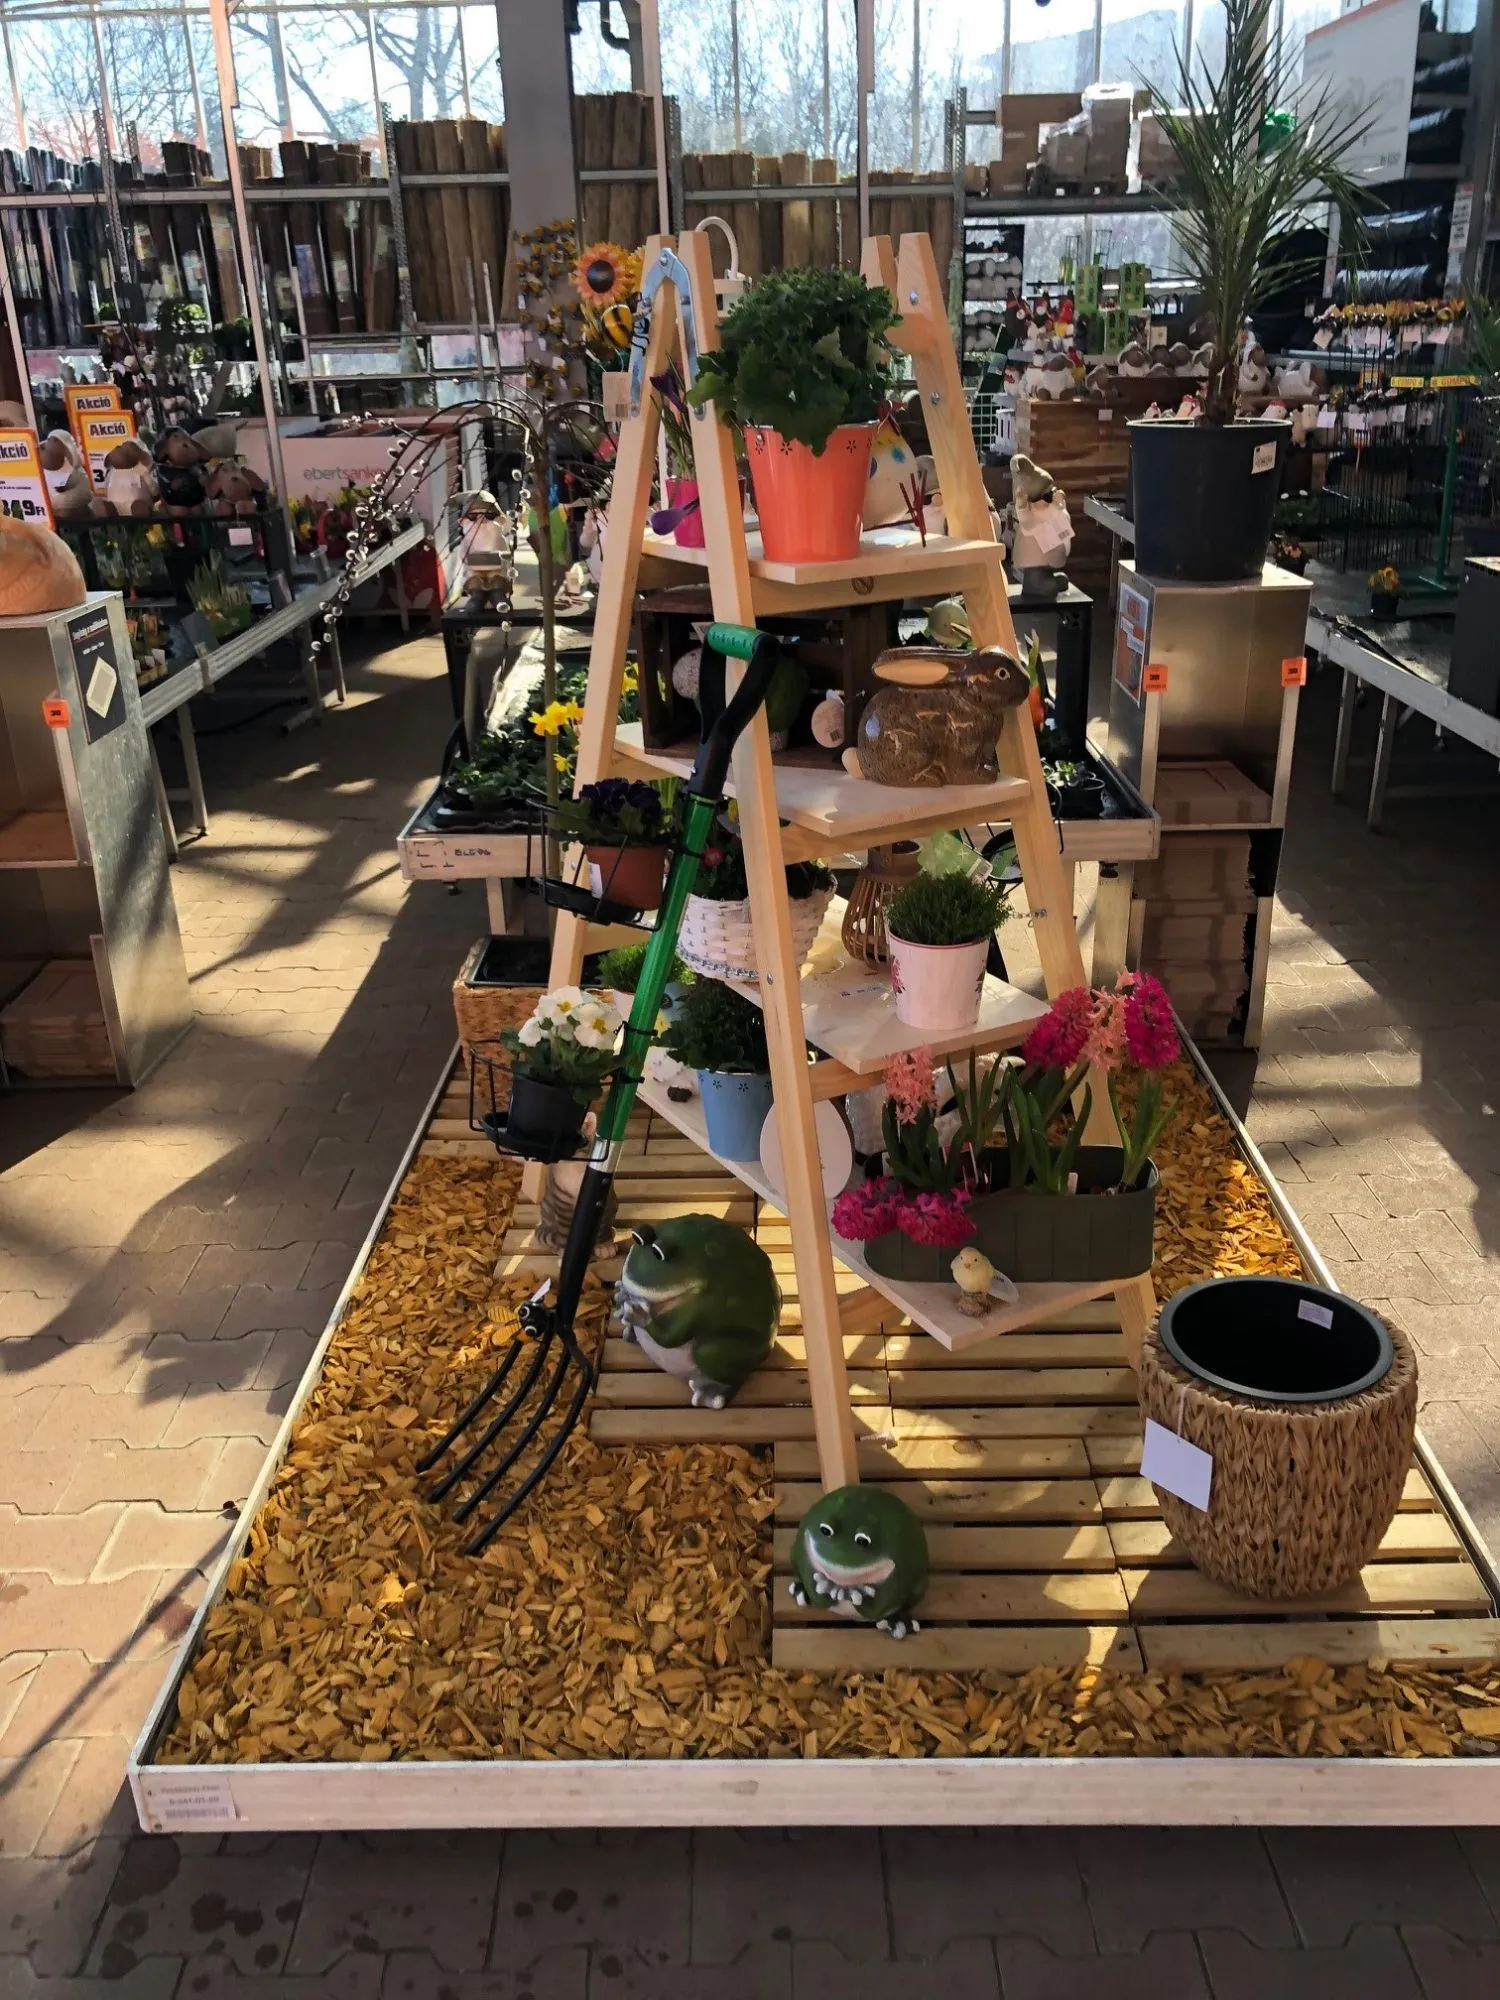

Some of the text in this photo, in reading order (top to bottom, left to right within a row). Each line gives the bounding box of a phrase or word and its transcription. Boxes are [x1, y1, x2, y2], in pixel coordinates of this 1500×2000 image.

[77, 396, 111, 409] Akció
[90, 423, 126, 436] Akció
[0, 443, 28, 459] kció
[303, 466, 386, 481] ebertsanke
